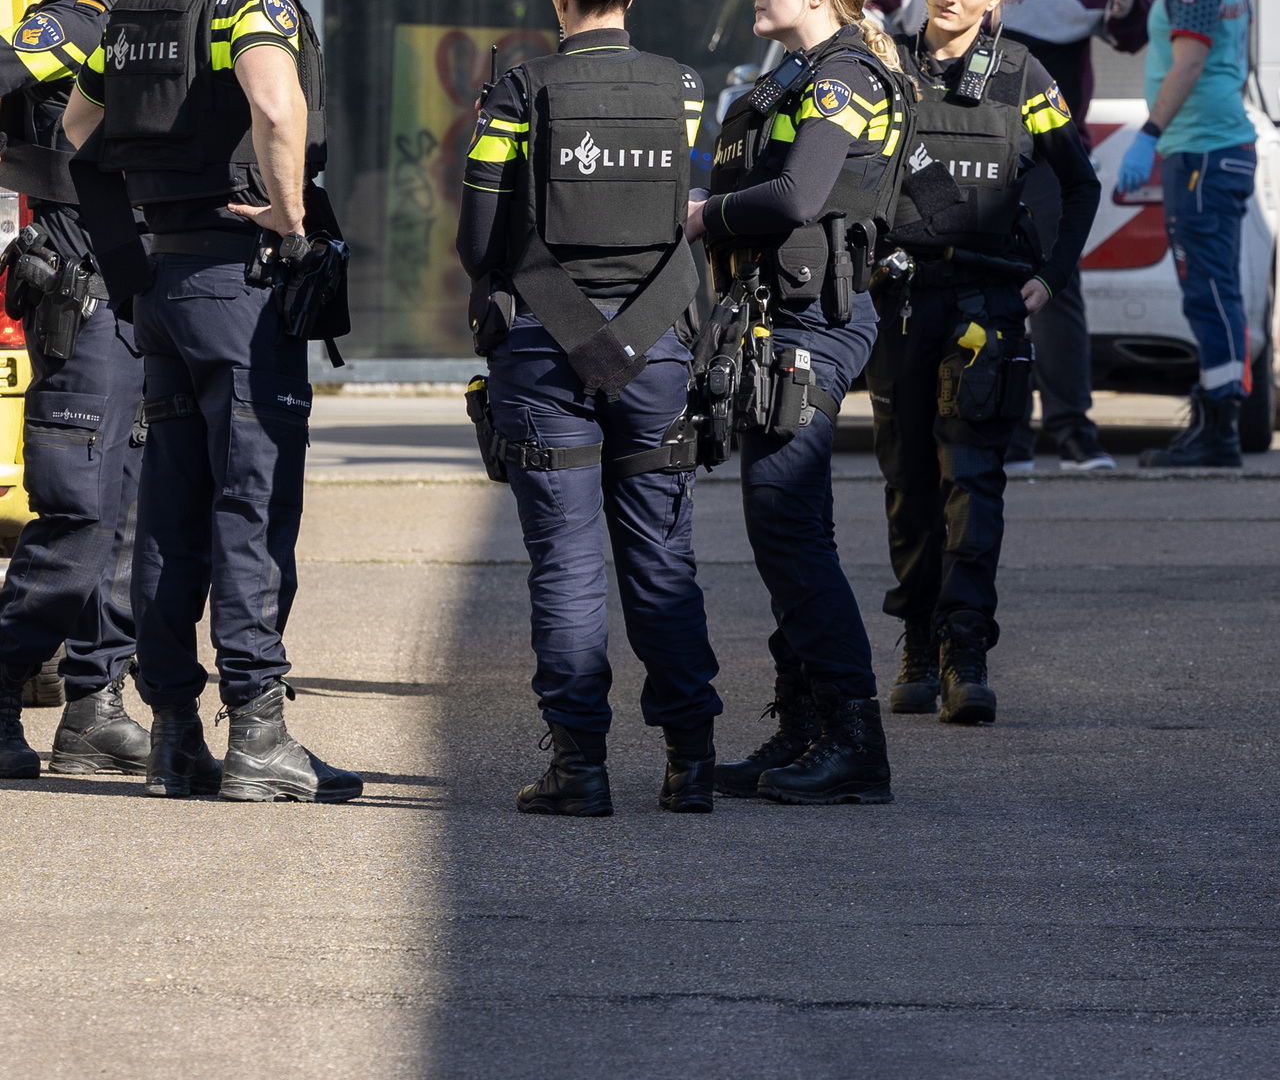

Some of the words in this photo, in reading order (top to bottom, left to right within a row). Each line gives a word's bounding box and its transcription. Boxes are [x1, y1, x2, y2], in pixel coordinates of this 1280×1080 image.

[36, 15, 60, 42] POLITIE
[106, 28, 179, 70] POLITIE
[818, 80, 849, 97] POLITIE
[560, 131, 673, 175] POLITIE
[797, 354, 809, 365] TQ
[61, 408, 91, 421] POLITIE
